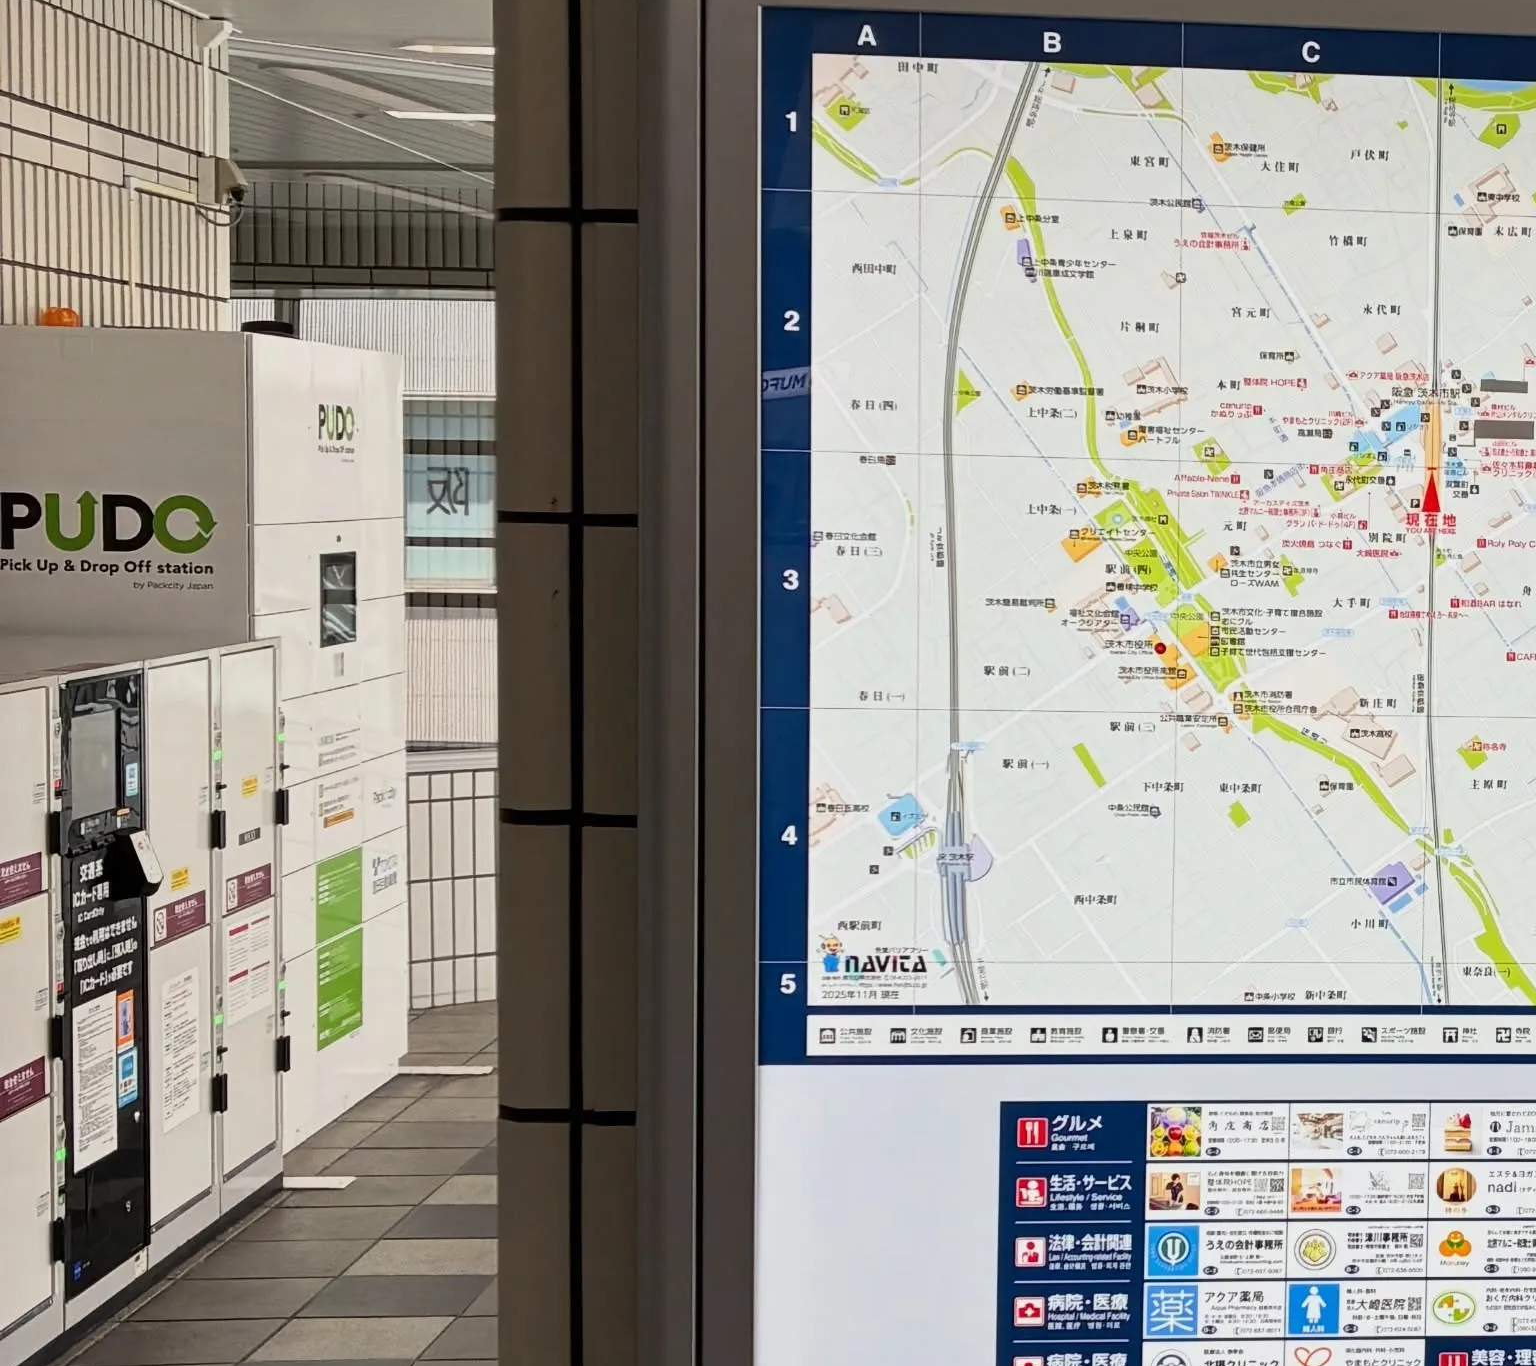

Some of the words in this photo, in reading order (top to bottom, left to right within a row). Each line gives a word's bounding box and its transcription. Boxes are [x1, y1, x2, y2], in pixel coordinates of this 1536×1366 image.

[858, 25, 877, 46] A
[1044, 32, 1061, 52] B
[1302, 42, 1320, 63] C
[786, 111, 797, 131] 1
[784, 310, 800, 331] 2
[318, 404, 355, 441] PUDO
[0, 490, 217, 554] PUDO
[1406, 514, 1456, 526] 現在地
[0, 559, 32, 572] Pick
[36, 560, 58, 574] Up
[63, 561, 75, 572] &
[80, 561, 119, 576] Drop
[124, 560, 151, 574] Off
[157, 561, 213, 574] station
[782, 569, 799, 590] 3
[781, 825, 798, 845] 4
[780, 974, 796, 994] 5
[1051, 1115, 1103, 1131] グルメ
[1051, 1134, 1087, 1142] Gourmet
[1050, 1175, 1132, 1191] 生活・サービス
[1049, 1235, 1132, 1252] 法律・会計関連
[1205, 1239, 1283, 1250] うえの会計事務所
[1048, 1294, 1128, 1311] 病院・医療
[1205, 1291, 1264, 1303] アクア薬局
[1150, 1285, 1193, 1332] 薬
